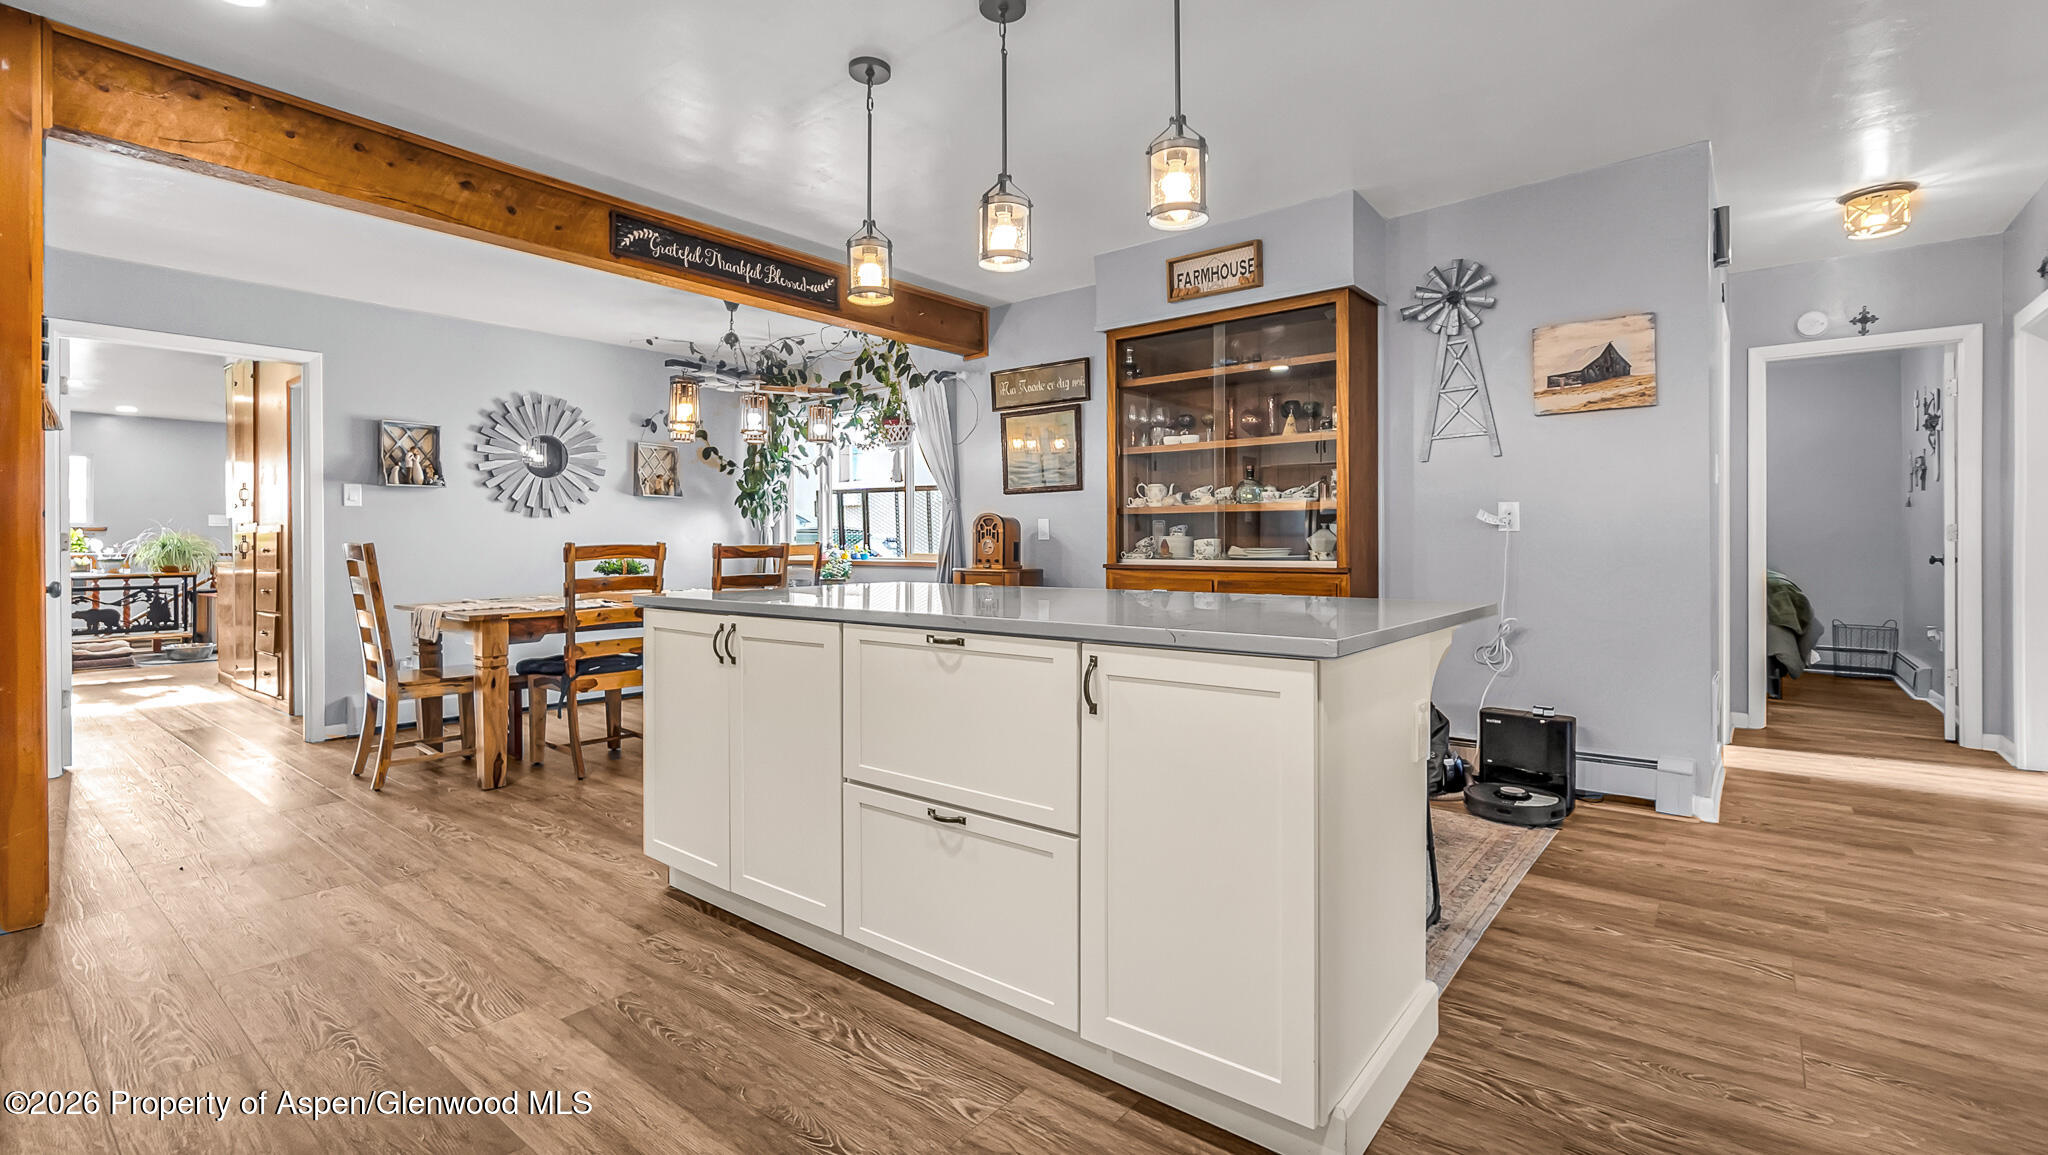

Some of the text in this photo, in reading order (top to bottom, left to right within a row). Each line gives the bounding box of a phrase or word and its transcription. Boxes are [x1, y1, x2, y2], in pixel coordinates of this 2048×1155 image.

[649, 233, 808, 292] Grateful Thankful Blessed
[1176, 257, 1255, 289] FARMHOUSE
